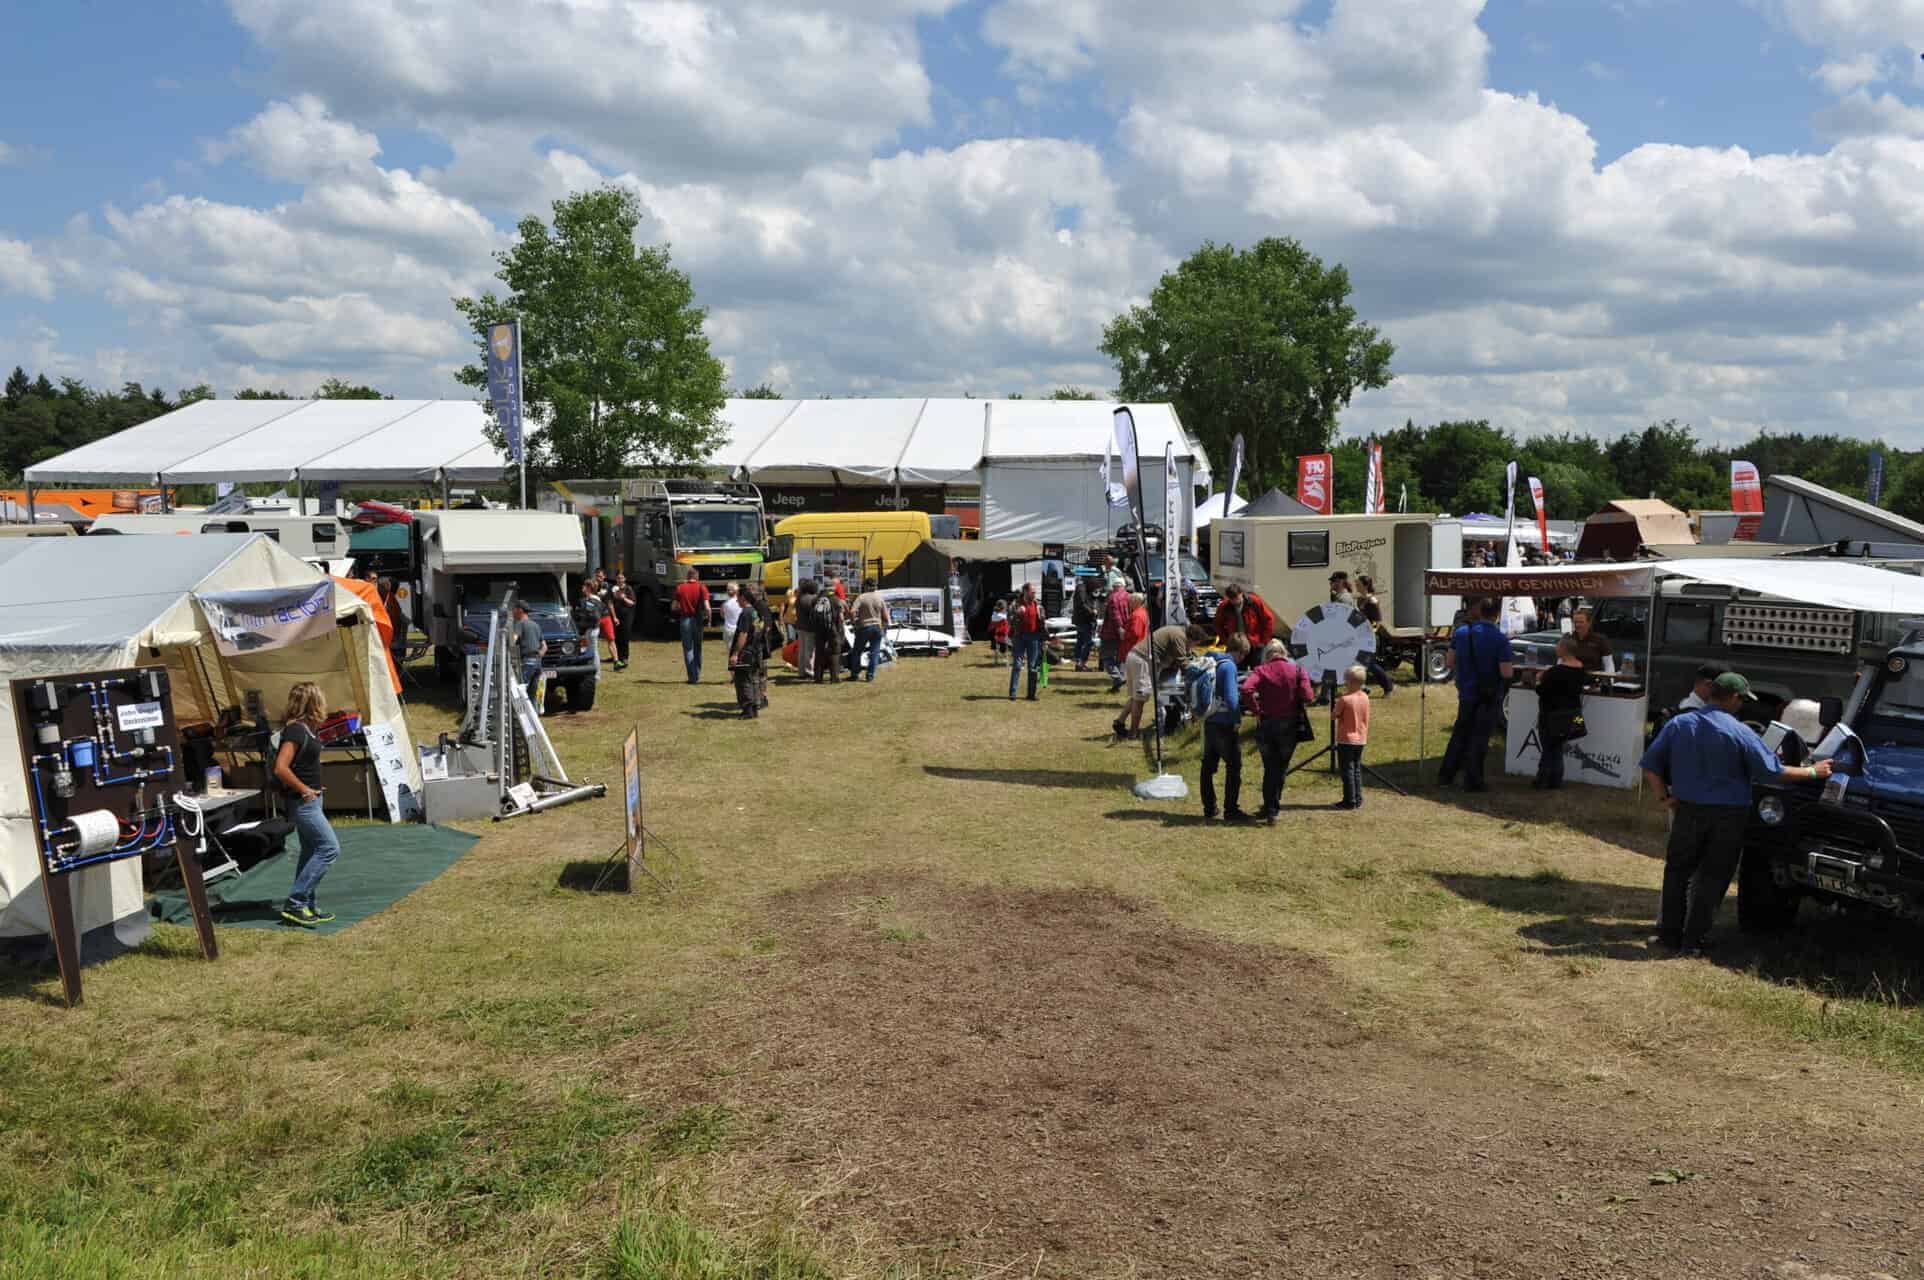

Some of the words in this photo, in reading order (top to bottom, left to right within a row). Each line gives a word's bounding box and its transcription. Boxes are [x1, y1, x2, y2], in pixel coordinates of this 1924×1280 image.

[772, 493, 805, 506] Jeep
[875, 494, 910, 507] Jeep
[1428, 576, 1513, 590] ALPENTOUR
[1518, 576, 1603, 591] GEWINNEN
